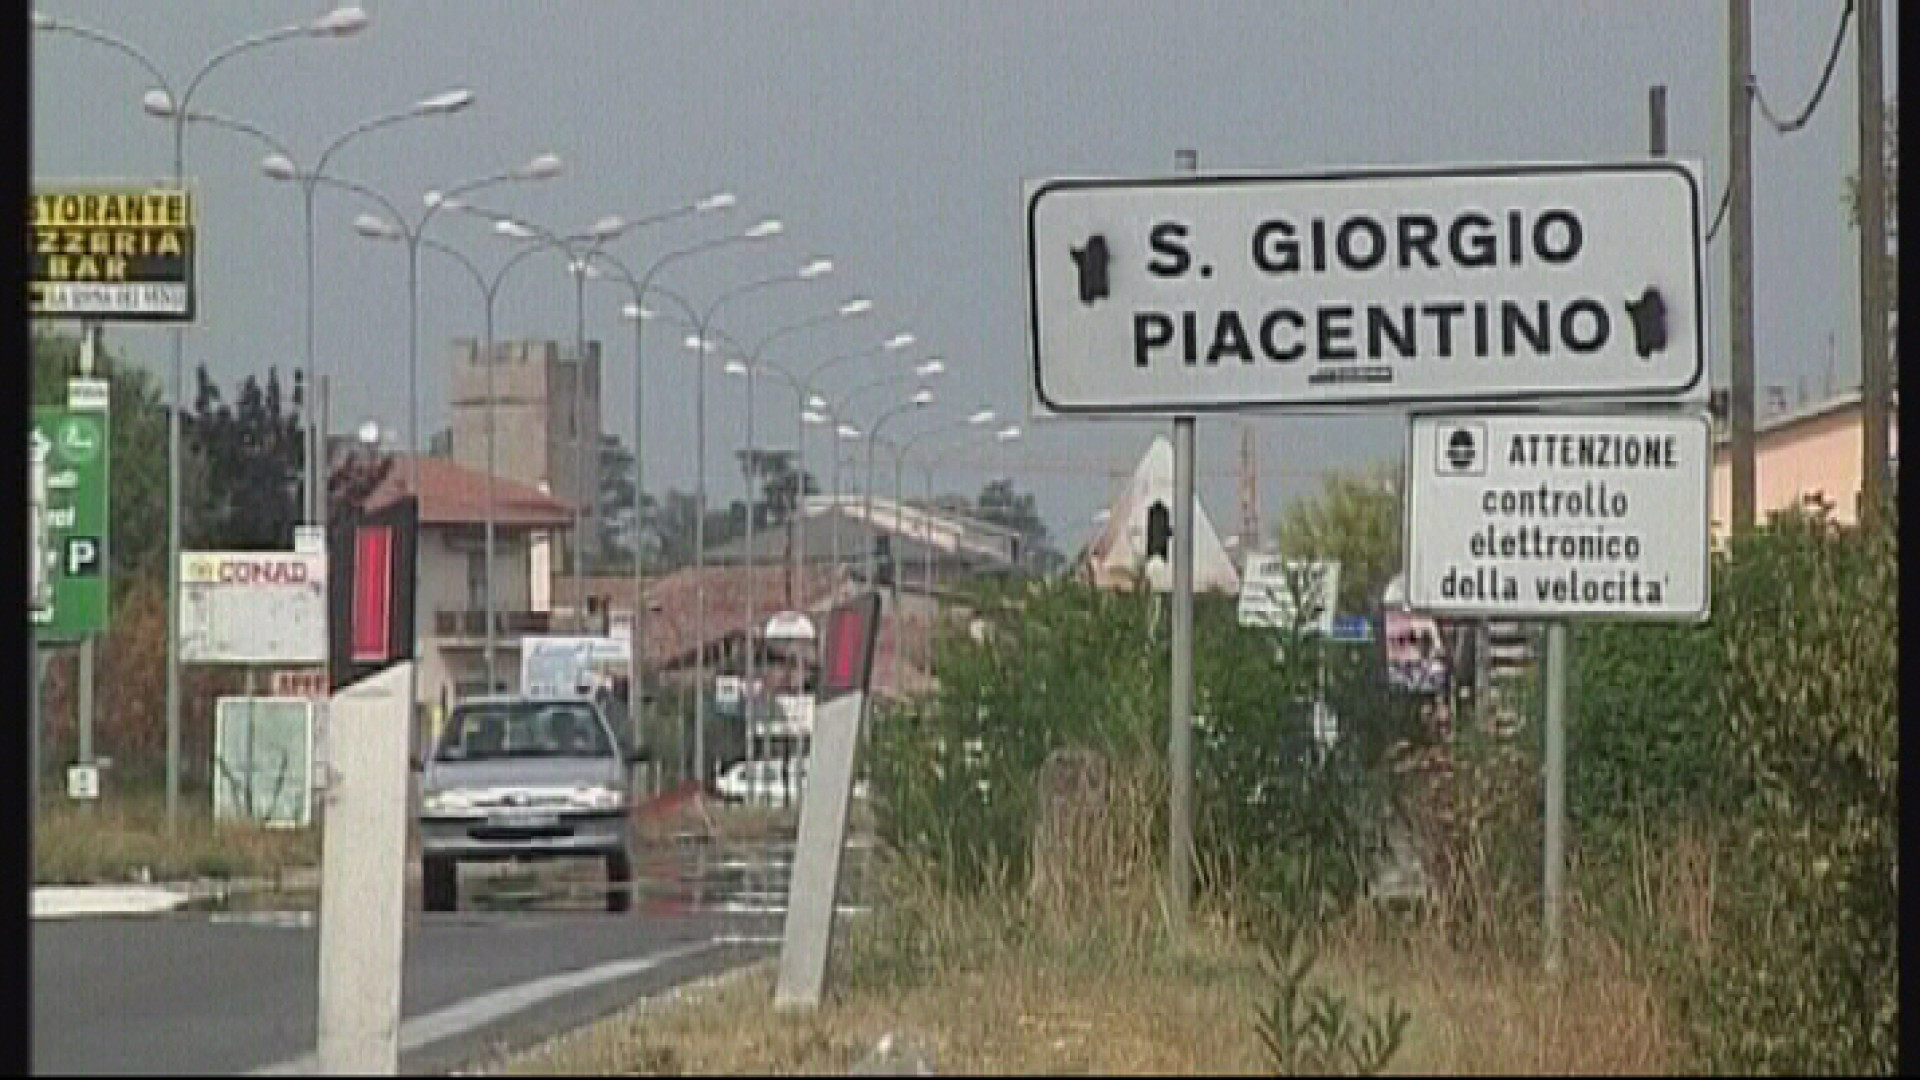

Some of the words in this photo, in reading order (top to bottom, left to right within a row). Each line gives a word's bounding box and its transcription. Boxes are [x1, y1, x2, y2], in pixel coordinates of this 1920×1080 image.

[27, 230, 181, 256] ZZERIA
[1147, 221, 1212, 278] S.
[1252, 209, 1584, 274] GIORGIO
[48, 254, 128, 281] BAR
[1133, 298, 1612, 368] PIACENTINO
[1508, 433, 1678, 468] ATTENZIONE
[1482, 481, 1629, 518] controllo
[69, 540, 96, 575] P
[1470, 524, 1641, 561] elettronico
[219, 561, 307, 585] CONAD
[1440, 565, 1519, 602] della
